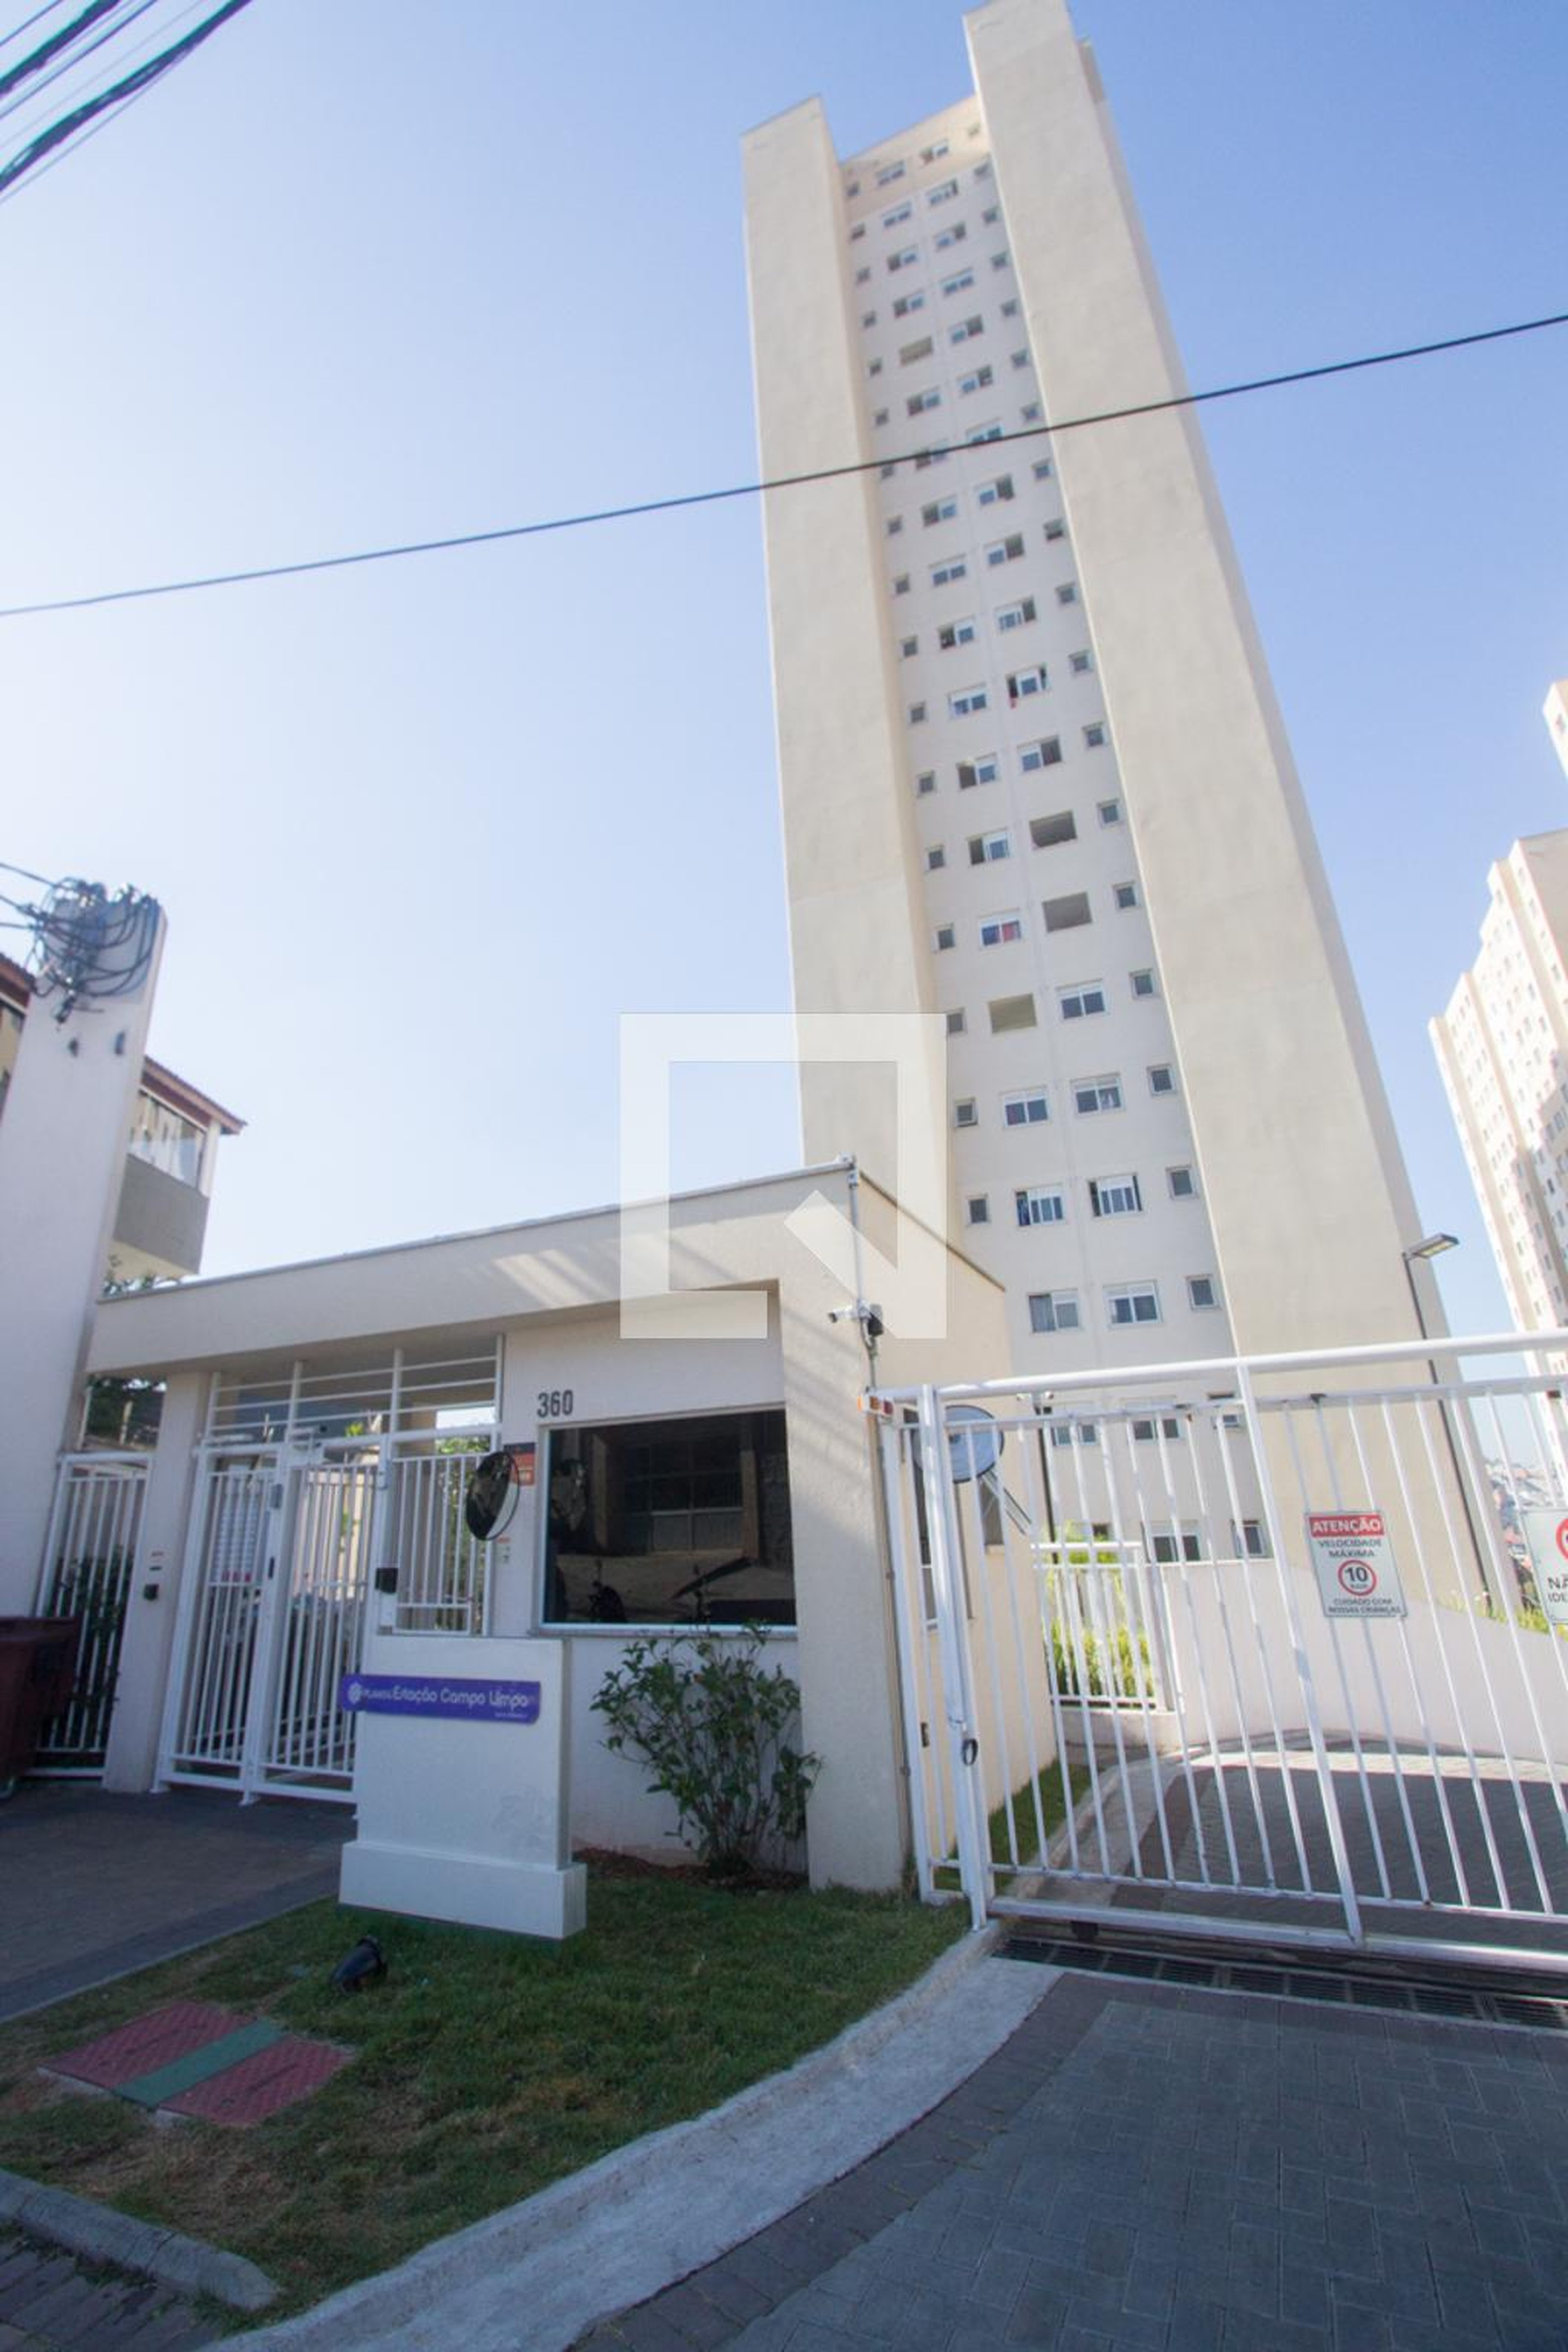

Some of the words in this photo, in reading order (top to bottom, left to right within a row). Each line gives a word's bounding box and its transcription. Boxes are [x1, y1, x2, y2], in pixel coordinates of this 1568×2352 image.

[537, 1389, 573, 1418] 360
[1312, 1516, 1380, 1533] ATENÇÃO
[1319, 1539, 1382, 1547] VELOCIDADE
[1329, 1549, 1374, 1557] MÁXIMA
[1345, 1566, 1368, 1582] 10
[393, 1685, 437, 1704] Estação
[440, 1688, 486, 1708] Campo
[490, 1689, 528, 1710] Limpo
